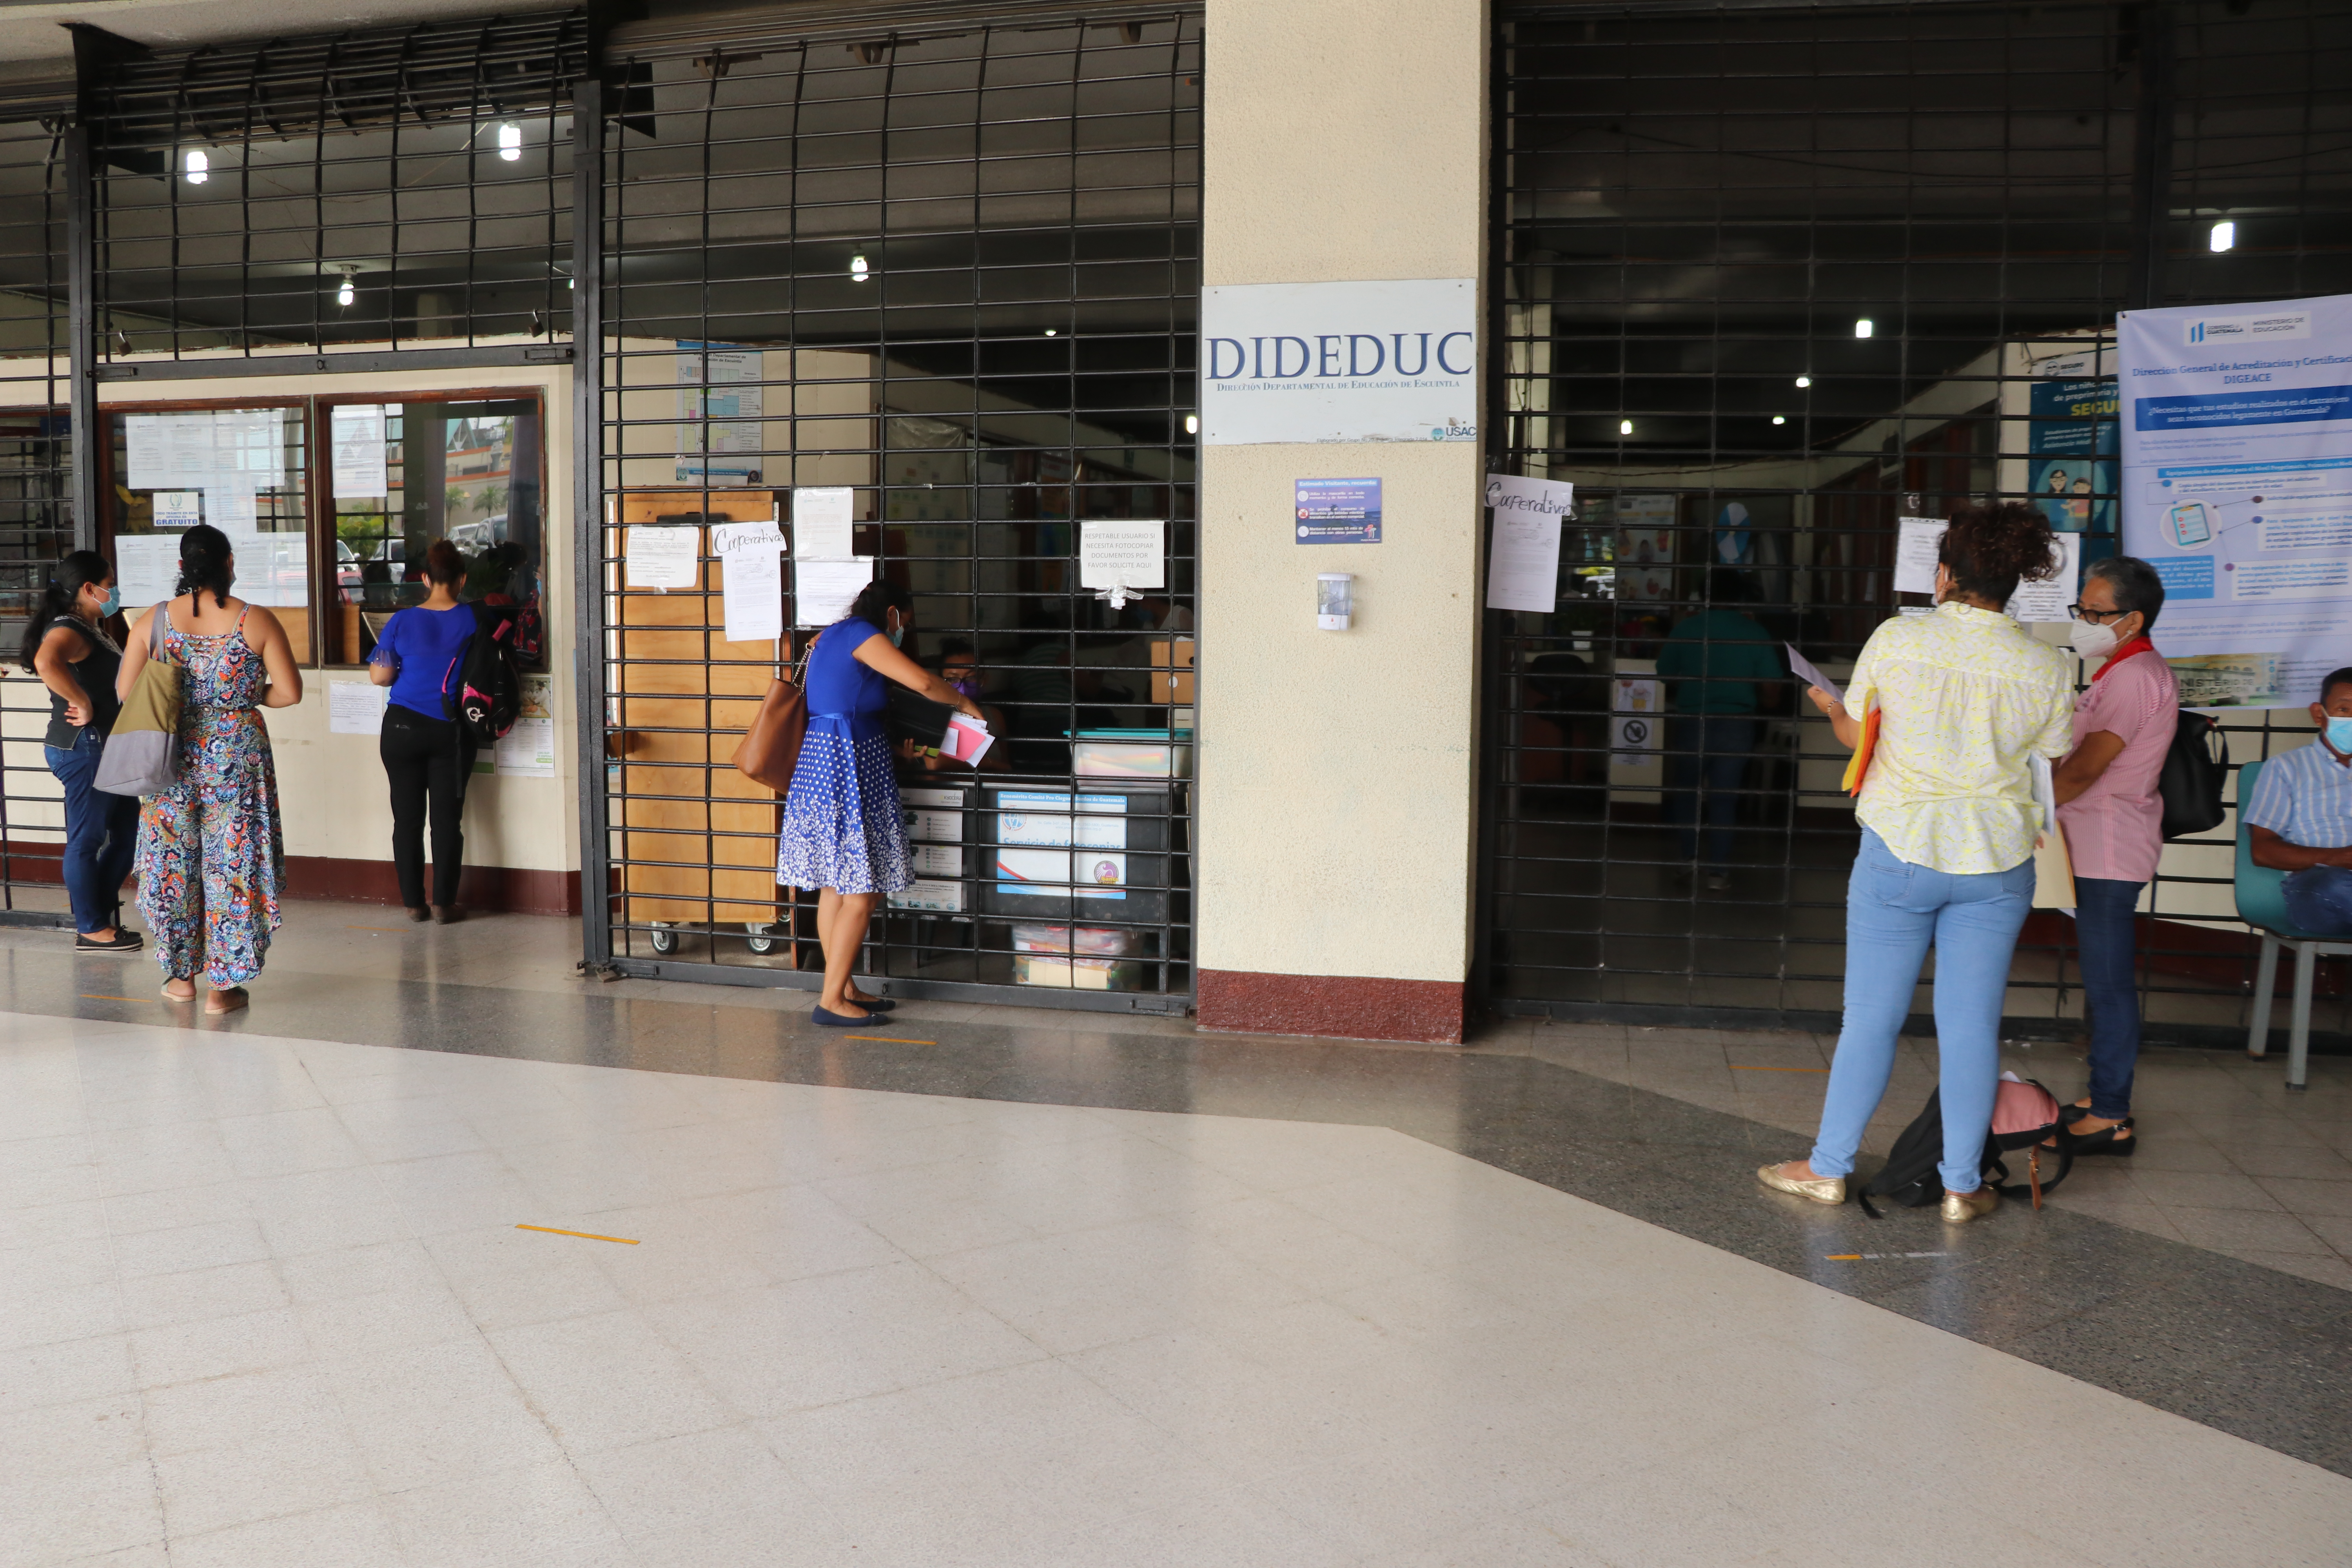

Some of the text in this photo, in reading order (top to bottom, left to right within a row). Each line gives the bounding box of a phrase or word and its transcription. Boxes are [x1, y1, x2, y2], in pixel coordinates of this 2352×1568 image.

[1205, 332, 1473, 379] DIDEDUC
[2132, 367, 2177, 376] Dirección
[2180, 363, 2217, 373] General
[2219, 363, 2230, 371] de
[2232, 359, 2293, 370] Acreditación
[2223, 373, 2272, 384] DIGEACE
[2249, 400, 2288, 408] realizados
[2186, 413, 2231, 421] reconocidos
[1446, 426, 1477, 436] USAC
[1485, 481, 1571, 515] Cooperativas
[714, 528, 784, 553] Cooperativas
